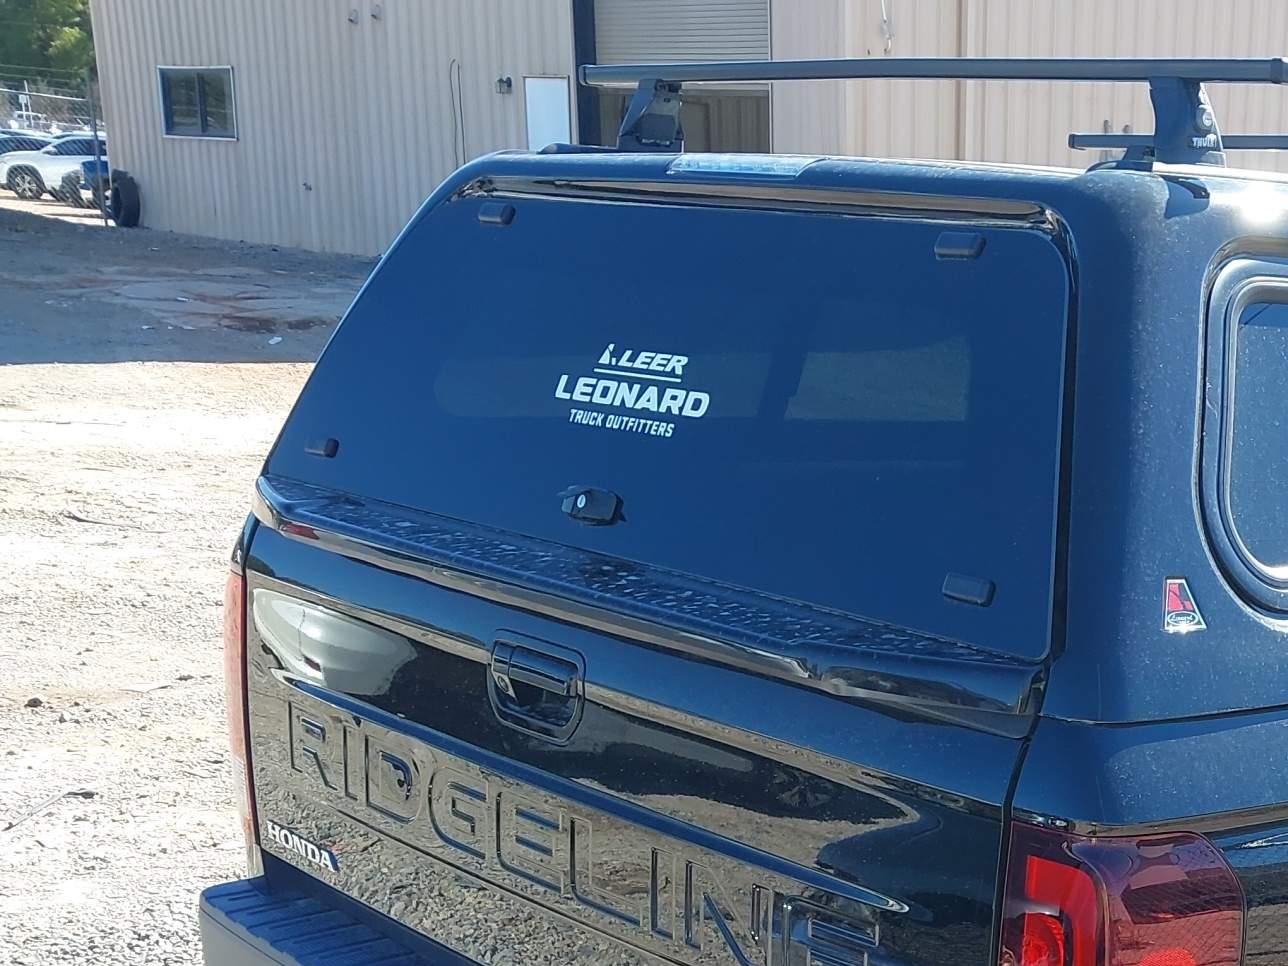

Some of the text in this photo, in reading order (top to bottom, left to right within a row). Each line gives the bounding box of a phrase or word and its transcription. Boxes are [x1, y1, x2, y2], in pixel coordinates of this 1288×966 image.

[617, 350, 689, 375] LEER
[555, 374, 710, 418] LEONARD
[568, 408, 675, 438] TRUCK OUTFITTERS
[266, 819, 339, 873] HONDA
